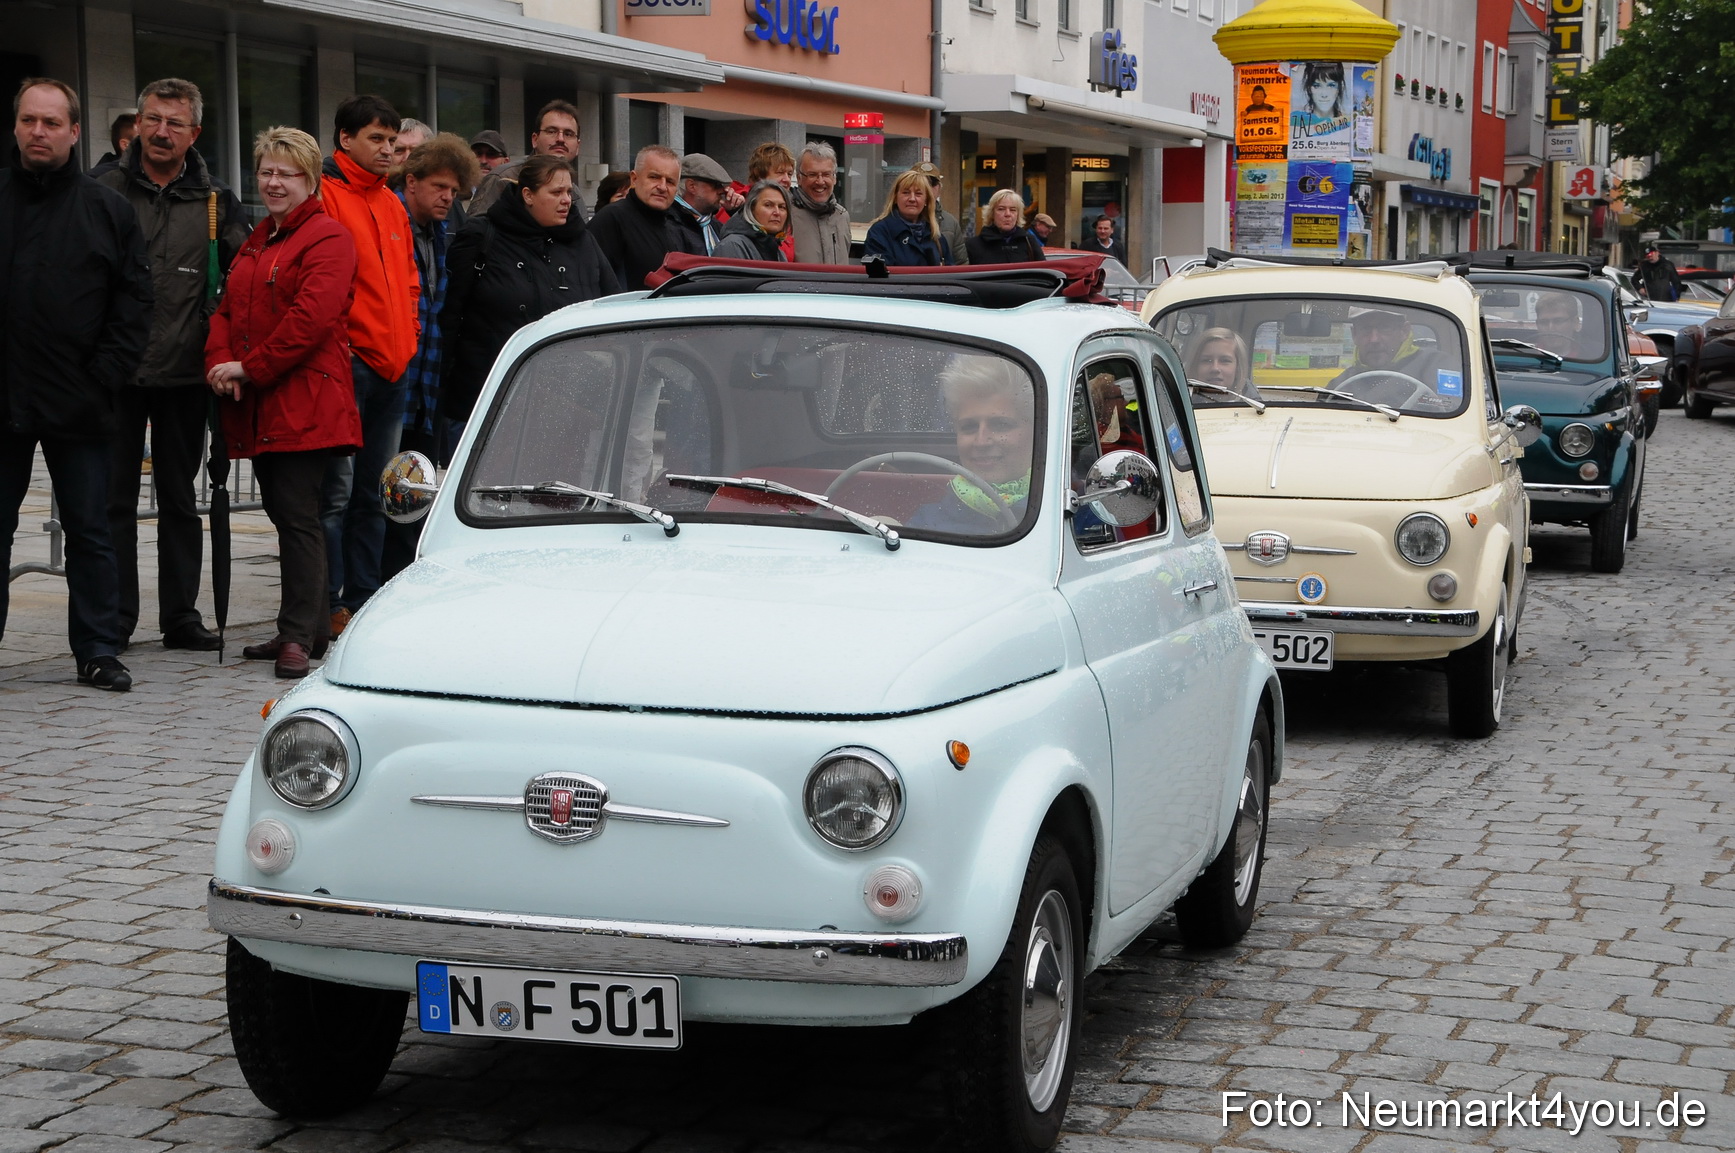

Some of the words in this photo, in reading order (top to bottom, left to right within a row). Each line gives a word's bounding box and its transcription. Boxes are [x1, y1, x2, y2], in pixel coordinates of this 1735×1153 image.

[1102, 28, 1138, 91] fries
[1241, 76, 1288, 85] Flohmarkt
[858, 114, 868, 127] T
[1243, 116, 1280, 126] Samstag
[1292, 113, 1314, 139] ZAZ
[1315, 122, 1337, 136] OPEN
[1338, 117, 1350, 129] AIR
[1243, 127, 1278, 137] 01.06.
[1292, 141, 1317, 150] 25.6.
[1551, 138, 1573, 146] Stern
[1071, 157, 1111, 168] FRIES
[1294, 217, 1315, 225] Metal
[1318, 217, 1338, 226] Night
[1273, 633, 1330, 664] 502
[429, 1004, 441, 1020] D
[449, 975, 484, 1027] N
[523, 980, 556, 1031] F
[570, 982, 674, 1038] 501
